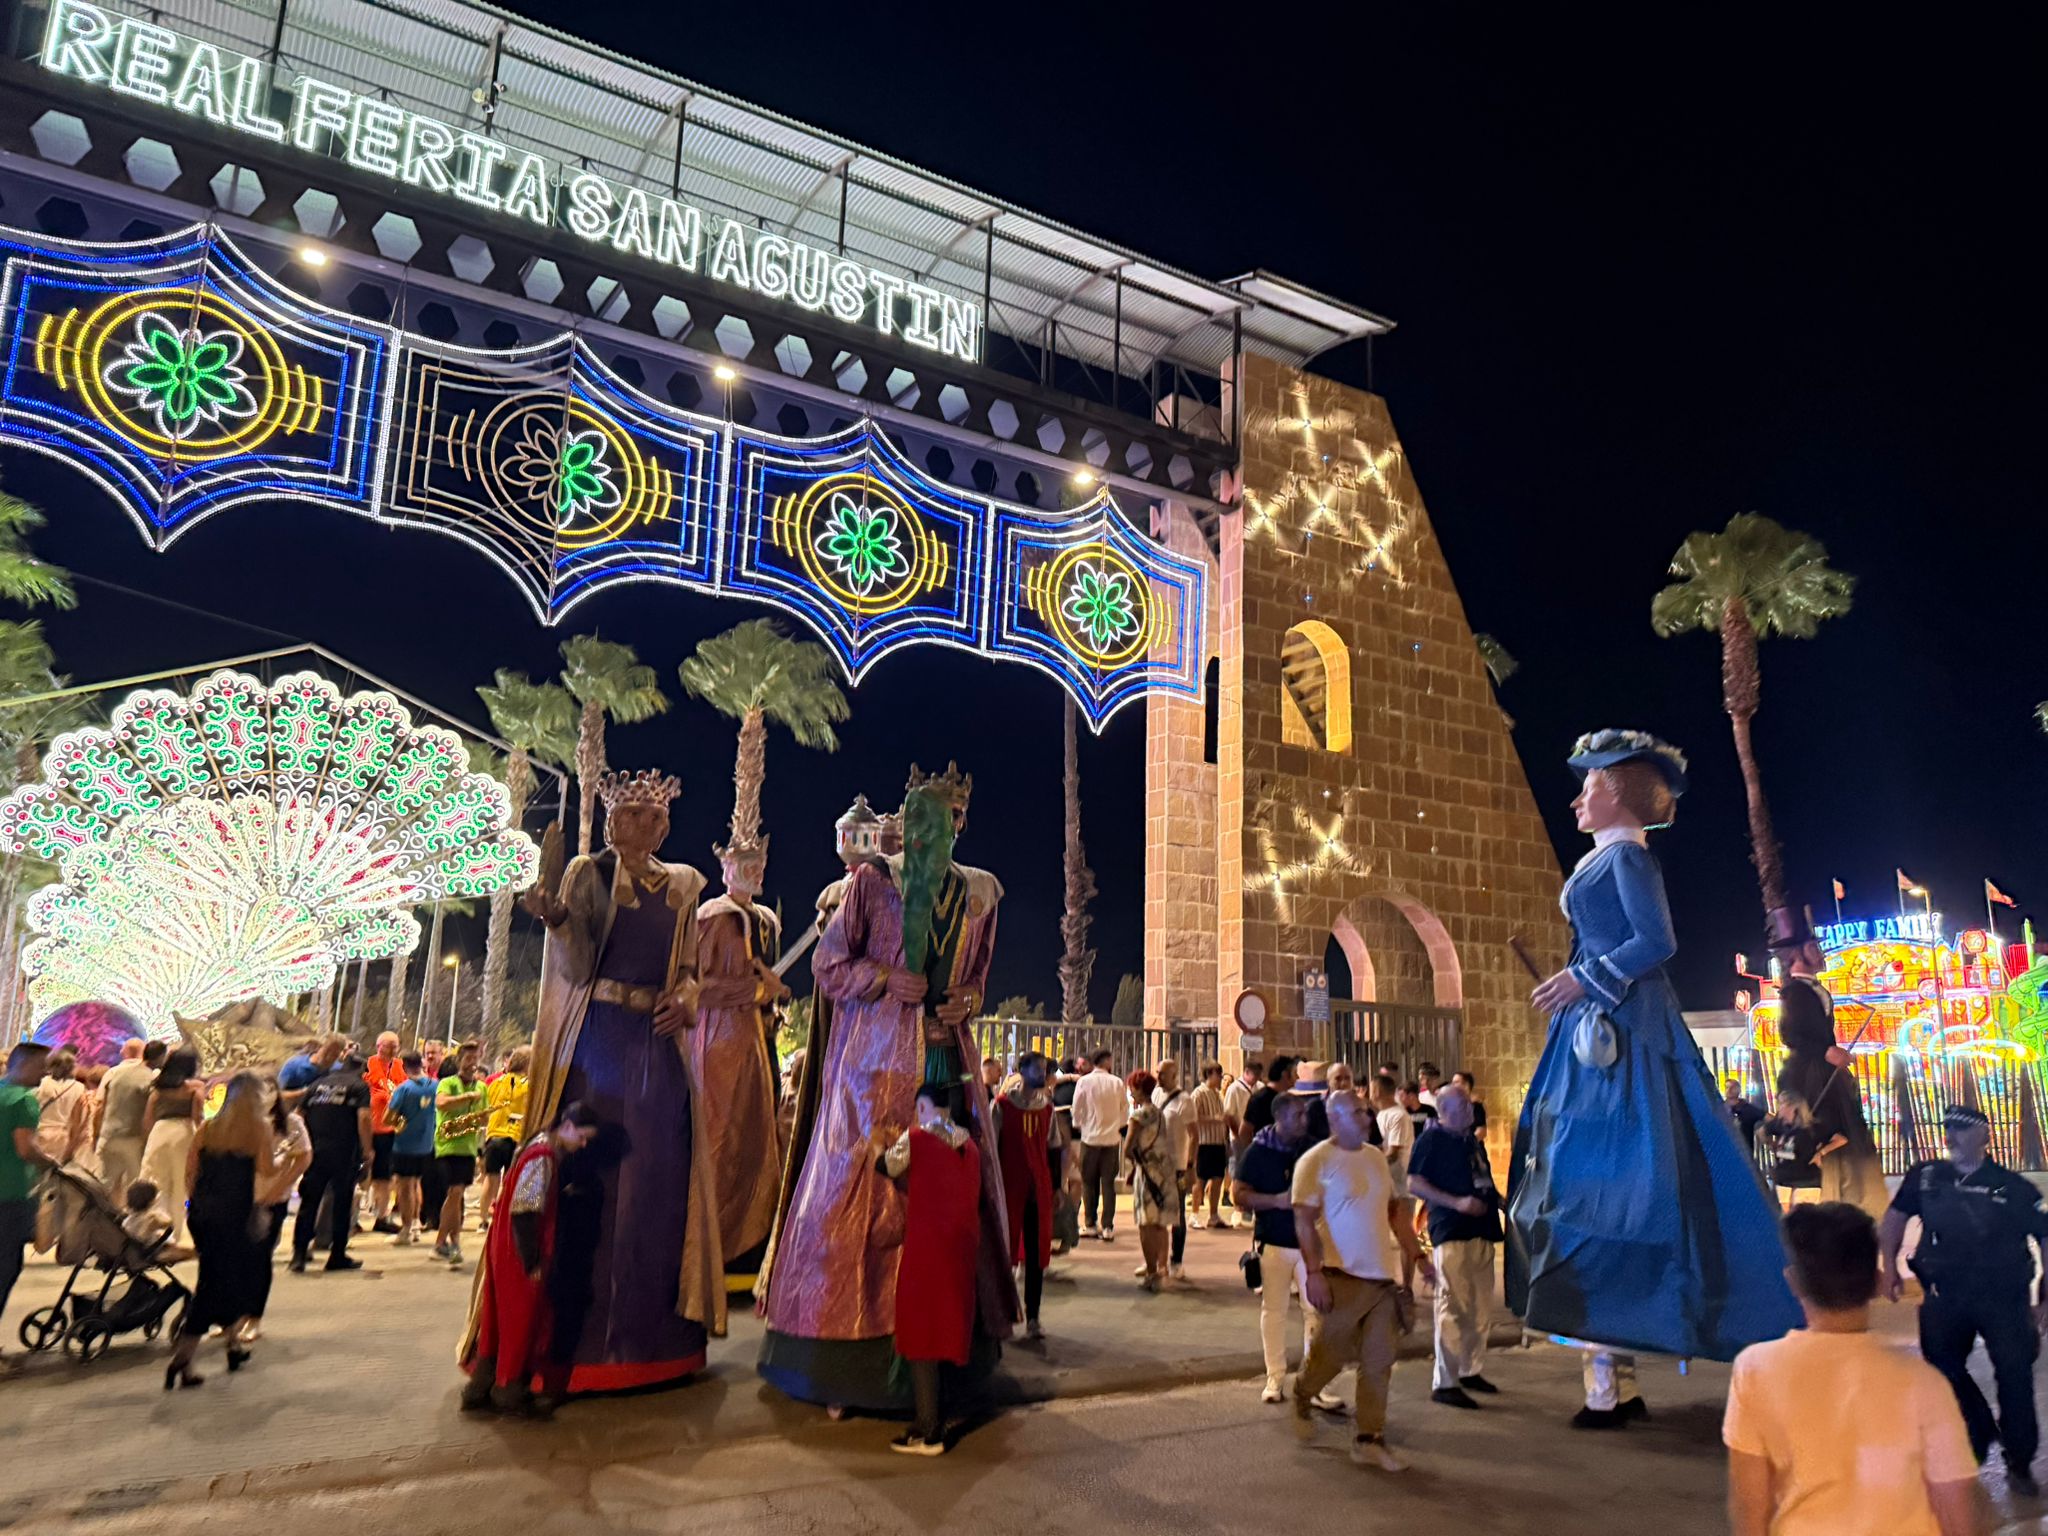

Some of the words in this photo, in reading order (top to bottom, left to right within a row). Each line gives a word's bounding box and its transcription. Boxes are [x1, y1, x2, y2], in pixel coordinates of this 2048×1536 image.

[42, 0, 284, 142] REAL
[295, 76, 550, 225] FERIA
[568, 175, 700, 271] SAN
[711, 220, 979, 363] AGUSTIN
[1874, 912, 1941, 939] FAMILY
